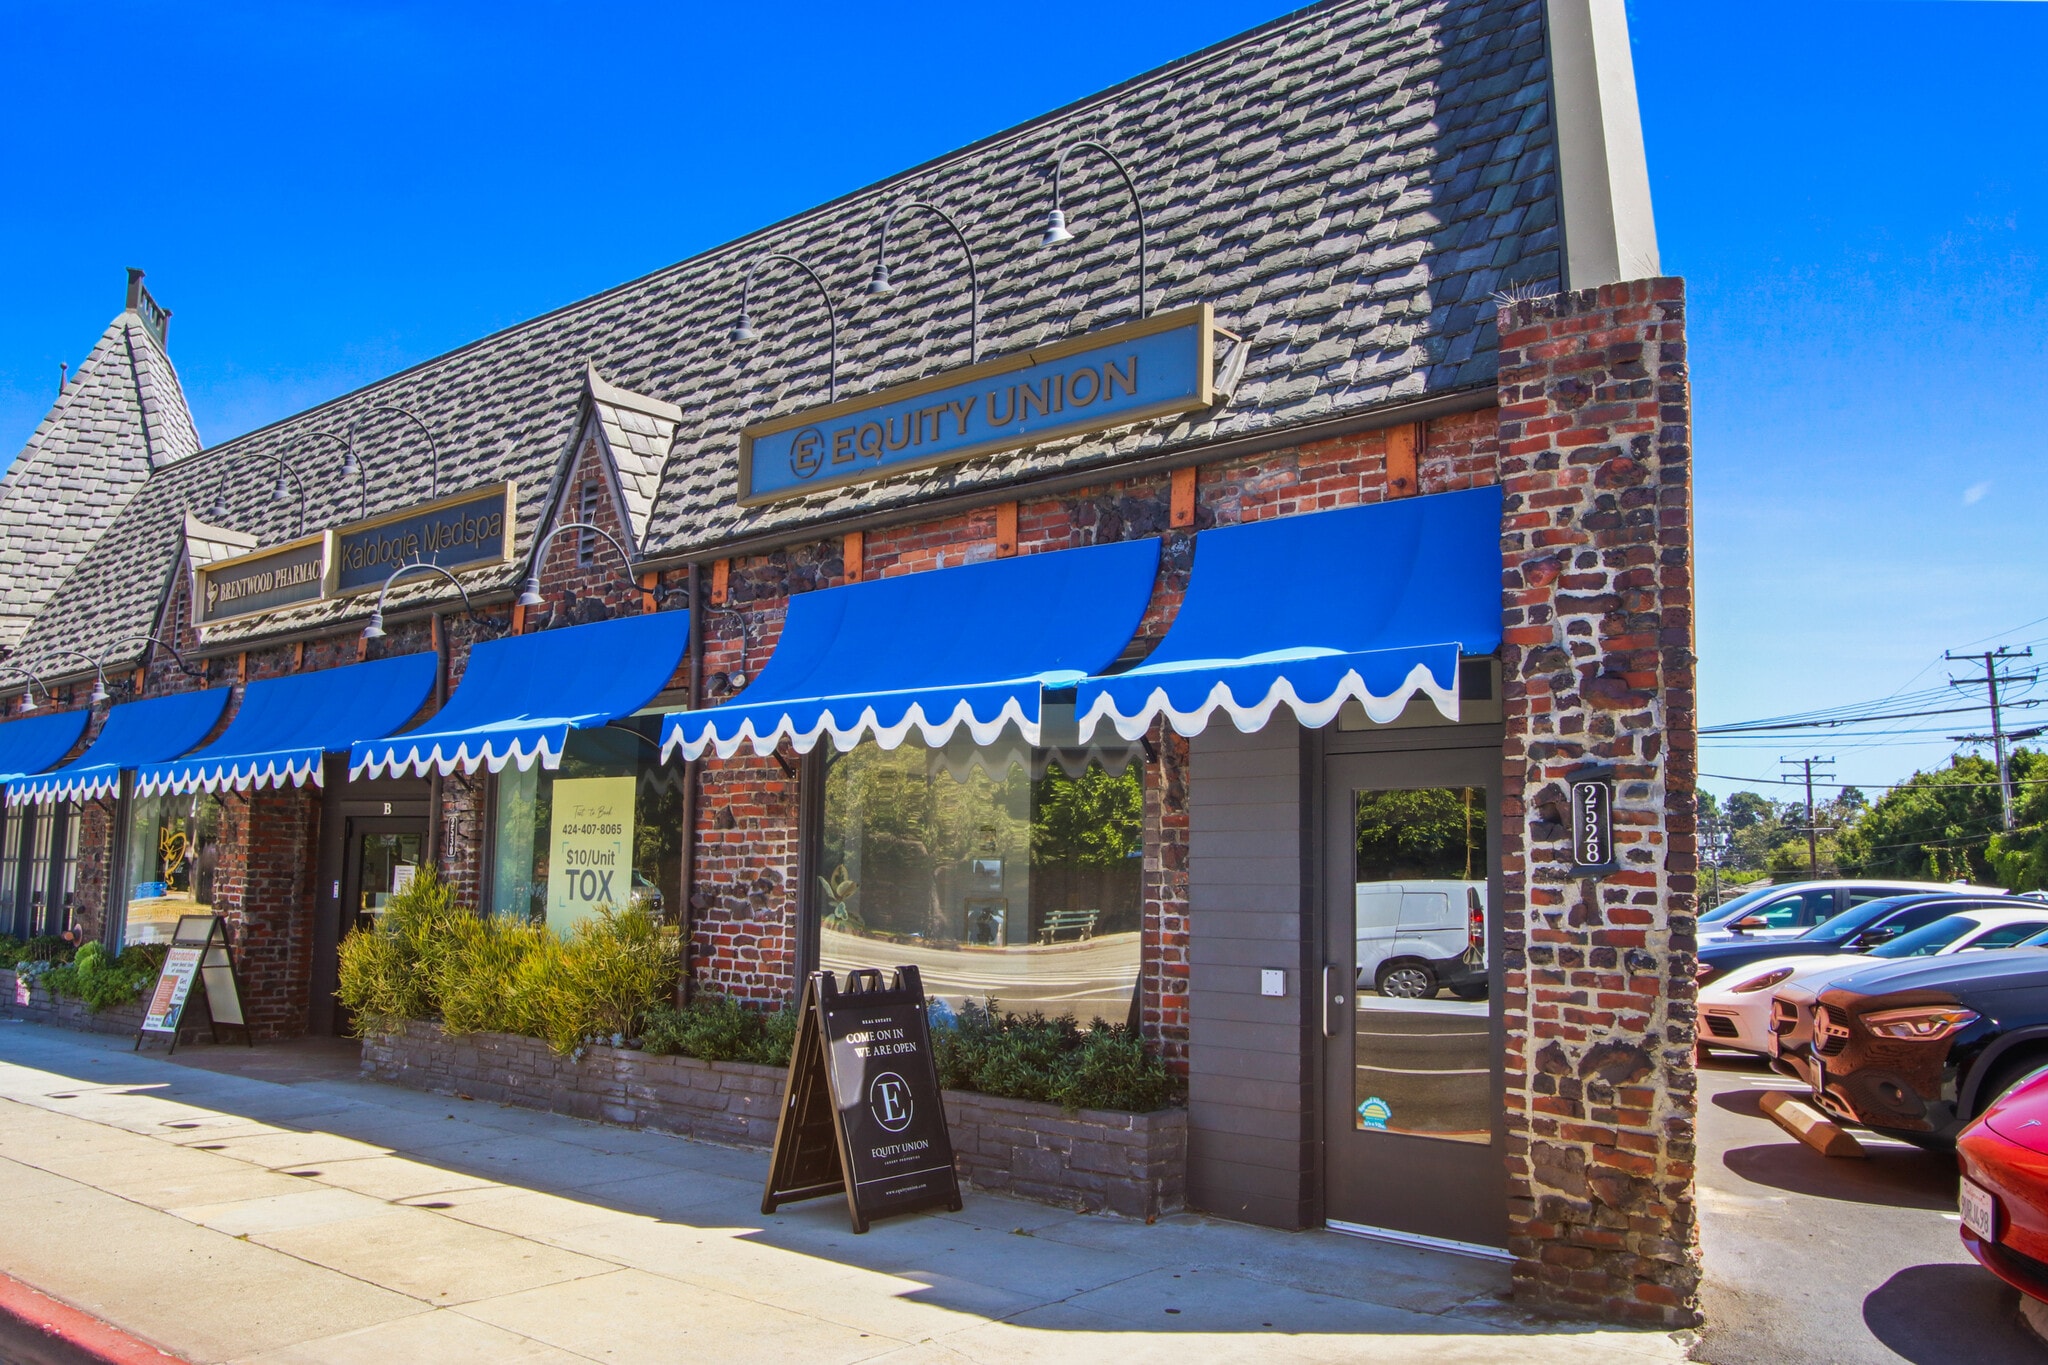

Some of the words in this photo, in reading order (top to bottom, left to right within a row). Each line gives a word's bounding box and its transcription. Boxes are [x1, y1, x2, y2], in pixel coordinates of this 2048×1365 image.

[831, 396, 977, 464] EQUITY
[986, 356, 1137, 426] UNION
[342, 533, 419, 571] Kalologie
[424, 512, 501, 550] Medspa
[220, 572, 273, 601] BRENTWOOD
[384, 803, 392, 815] B
[562, 824, 622, 835] 424-407-8065
[1584, 785, 1600, 862] 2528
[566, 849, 615, 866] $10/Unit
[565, 869, 614, 903] TOX
[846, 1031, 875, 1044] COME
[877, 1029, 891, 1041] ON
[893, 1028, 904, 1039] IN
[854, 1046, 871, 1058] WE
[873, 1044, 892, 1056] ARE
[893, 1042, 917, 1054] OPEN
[876, 1078, 908, 1125] E
[871, 1144, 900, 1158] EQUITY
[901, 1139, 929, 1153] UNION
